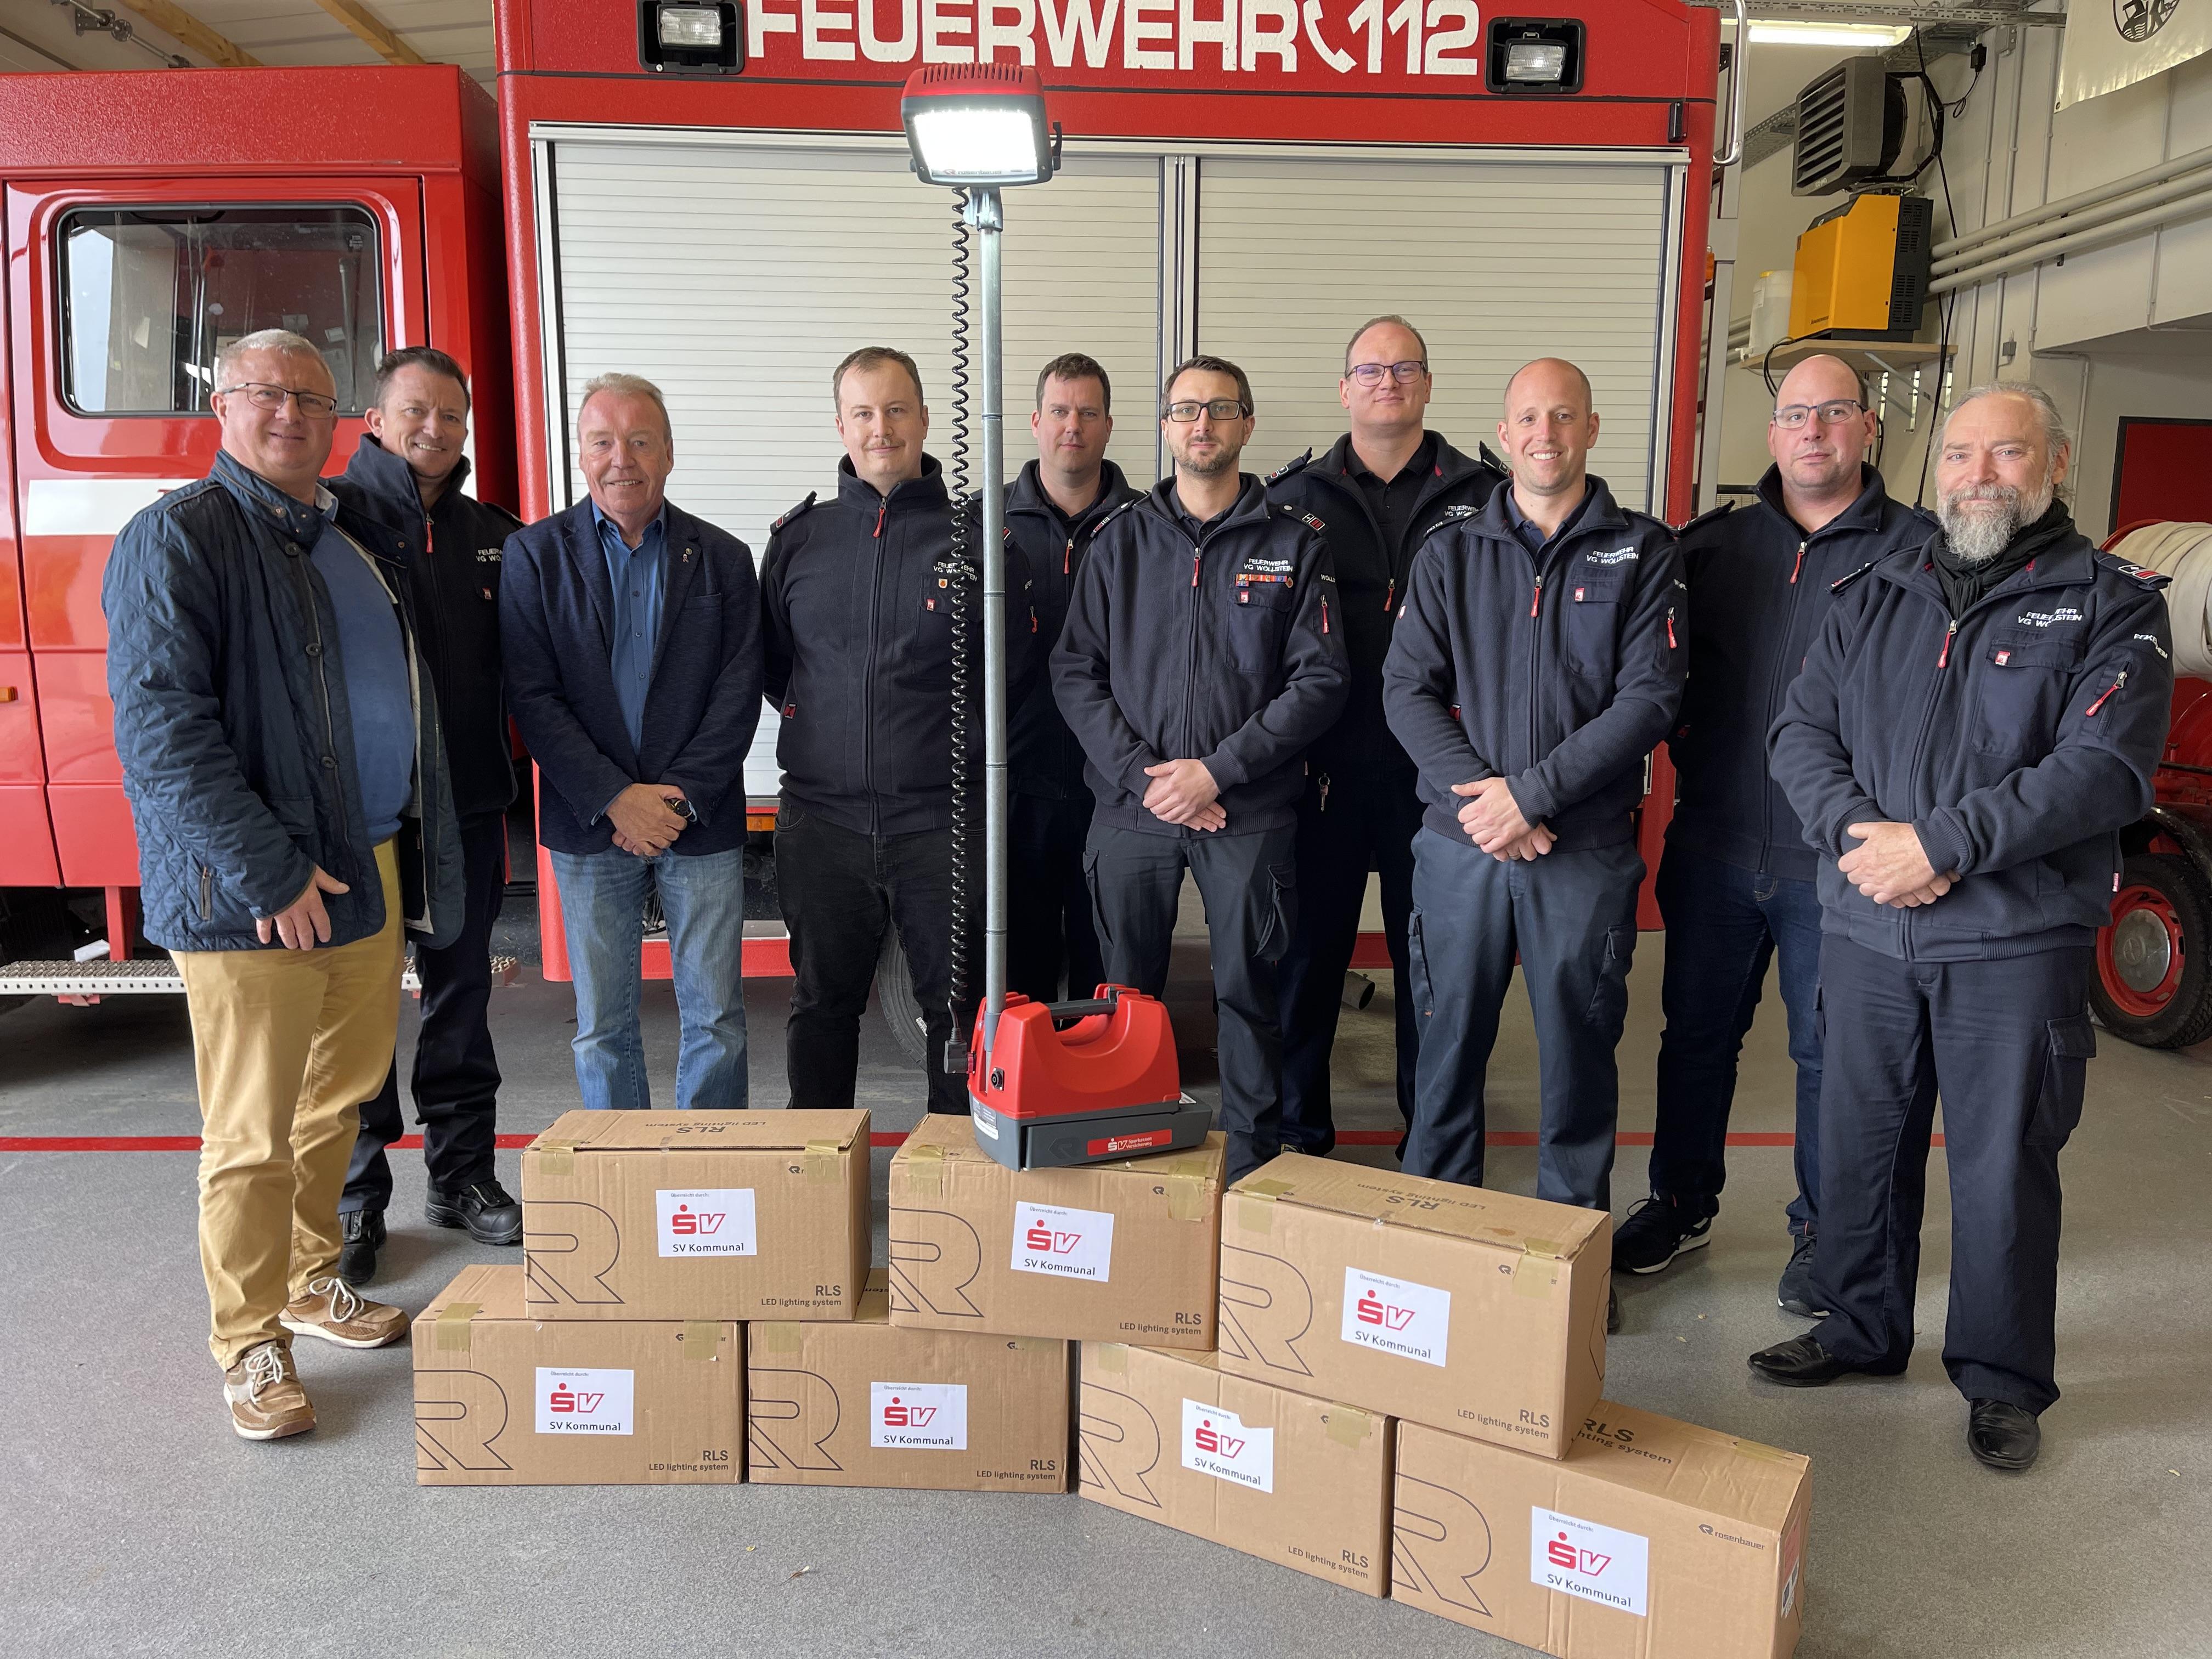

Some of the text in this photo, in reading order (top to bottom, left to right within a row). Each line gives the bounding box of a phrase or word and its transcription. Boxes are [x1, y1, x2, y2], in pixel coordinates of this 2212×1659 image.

[747, 0, 1479, 75] FEUERWEHR 112
[1593, 546, 1634, 557] FEUERWEHR
[2018, 616, 2032, 625] VG
[689, 1243, 744, 1252] Kommunal
[1024, 1259, 1096, 1276] SV Kommunal
[815, 1285, 842, 1296] RLS
[779, 1299, 810, 1307] lighting
[1175, 1312, 1201, 1325] RLS
[1138, 1324, 1169, 1334] lighting
[1171, 1326, 1201, 1335] system
[1355, 1330, 1431, 1359] SV Kommunal
[1457, 1408, 1549, 1440] LED lighting system
[1520, 1408, 1549, 1428] RLS
[550, 1421, 620, 1431] SV Kommunal
[1584, 1418, 1634, 1442] RLS
[884, 1435, 953, 1445] SV Kommunal
[1577, 1430, 1672, 1464] hting system
[703, 1450, 729, 1461] RLS
[667, 1463, 697, 1471] lighting
[1030, 1459, 1056, 1471] RLS
[1194, 1457, 1261, 1486] SV Kommunal
[994, 1471, 1024, 1480] lighting
[1026, 1472, 1056, 1481] system
[1714, 1531, 1766, 1550] rosenbauer
[1288, 1545, 1368, 1579] LED lighting system
[1342, 1549, 1368, 1568] RLS
[1547, 1573, 1632, 1607] SV Kommunal
